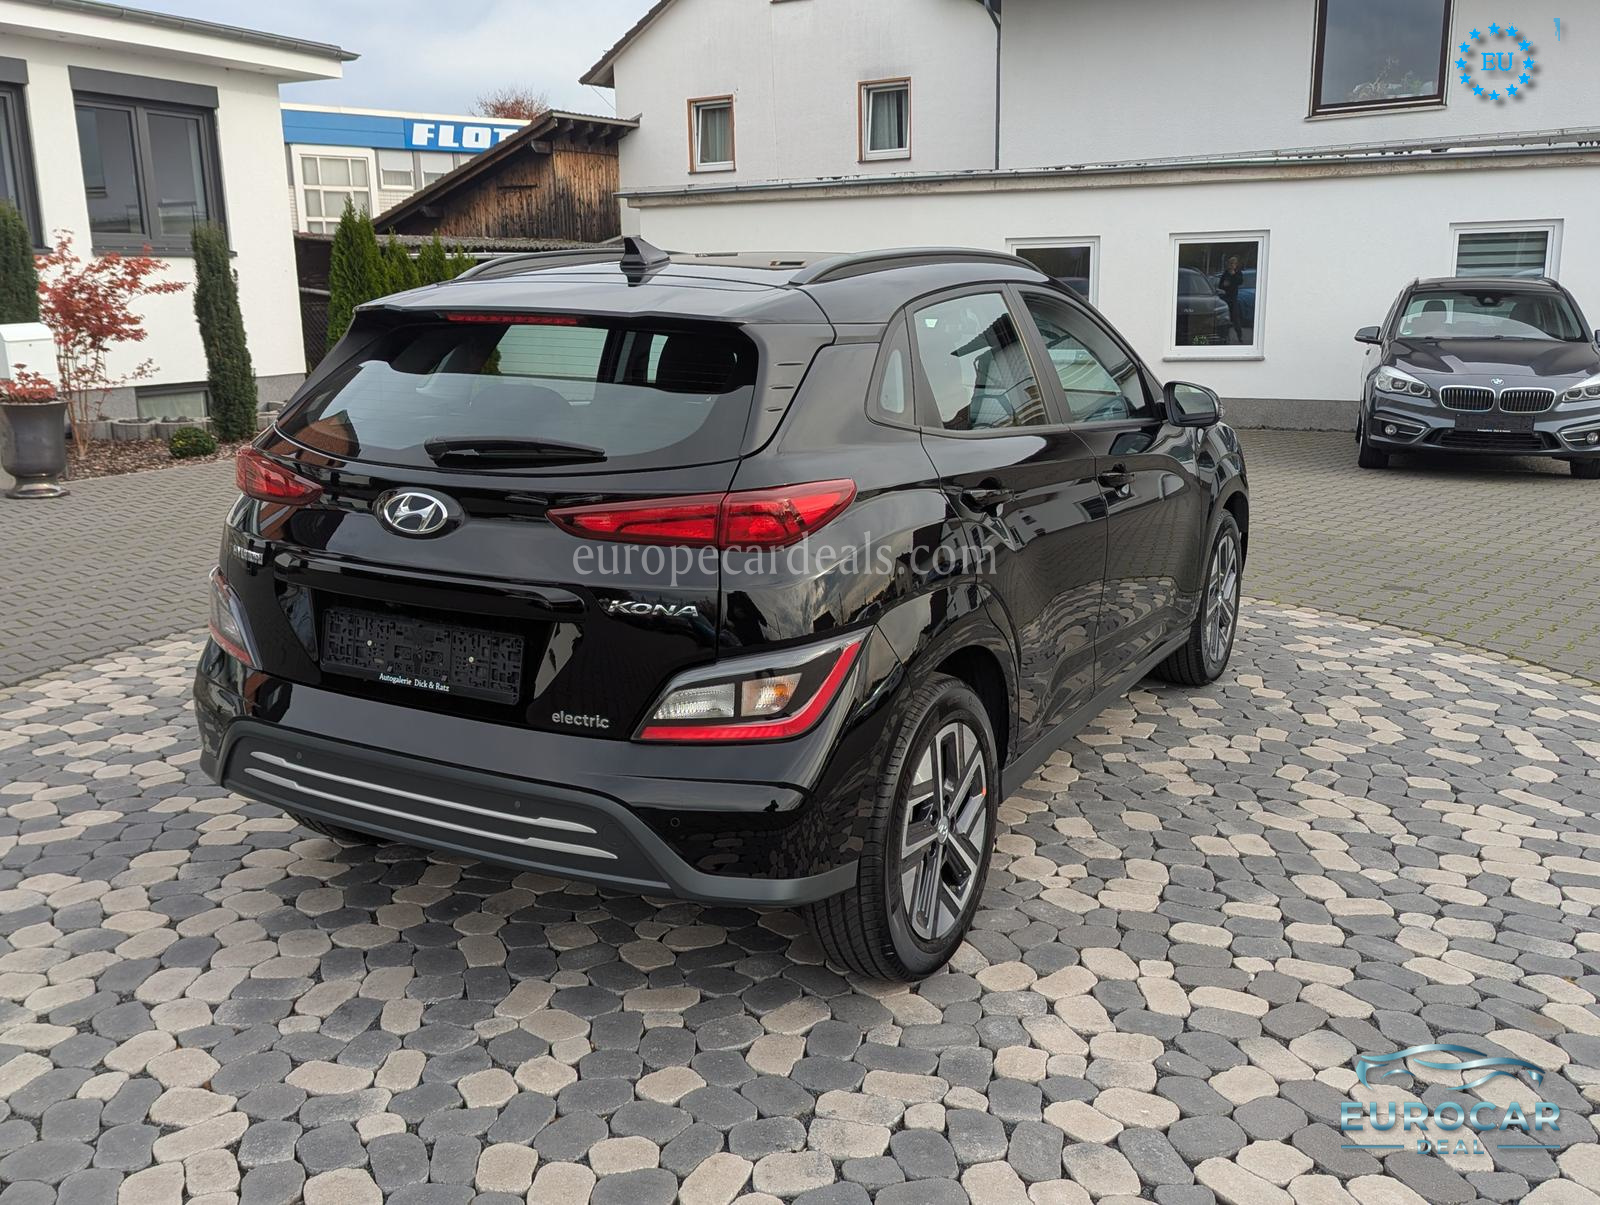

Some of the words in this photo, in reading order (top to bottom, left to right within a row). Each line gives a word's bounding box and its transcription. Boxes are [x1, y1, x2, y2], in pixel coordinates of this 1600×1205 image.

[607, 600, 699, 617] KONA
[379, 673, 412, 685] Autogalerie
[414, 679, 428, 688] Dick
[428, 681, 436, 689] &
[435, 683, 450, 692] Ratz
[552, 710, 610, 729] electric
